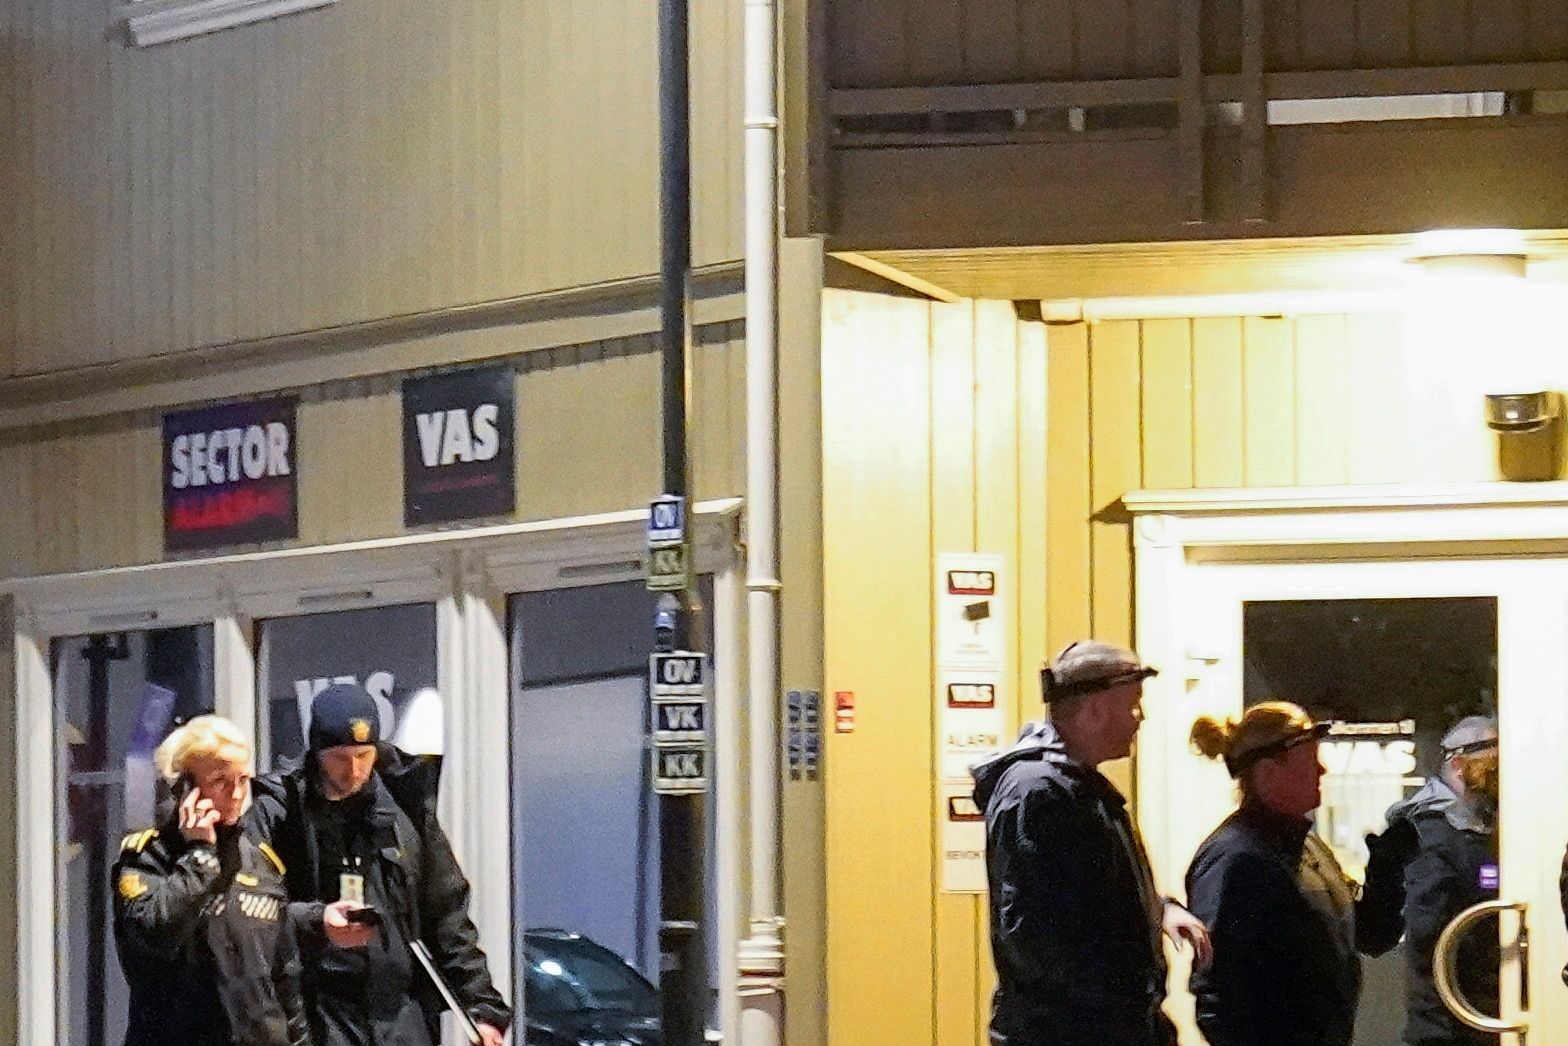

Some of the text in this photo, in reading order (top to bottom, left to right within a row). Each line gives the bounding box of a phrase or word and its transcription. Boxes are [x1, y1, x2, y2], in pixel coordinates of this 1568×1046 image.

[171, 422, 291, 489] SECTOR
[415, 403, 499, 467] VAS
[295, 671, 395, 750] VS
[664, 705, 699, 730] VK
[664, 752, 699, 778] KK
[1318, 740, 1417, 774] VAS
